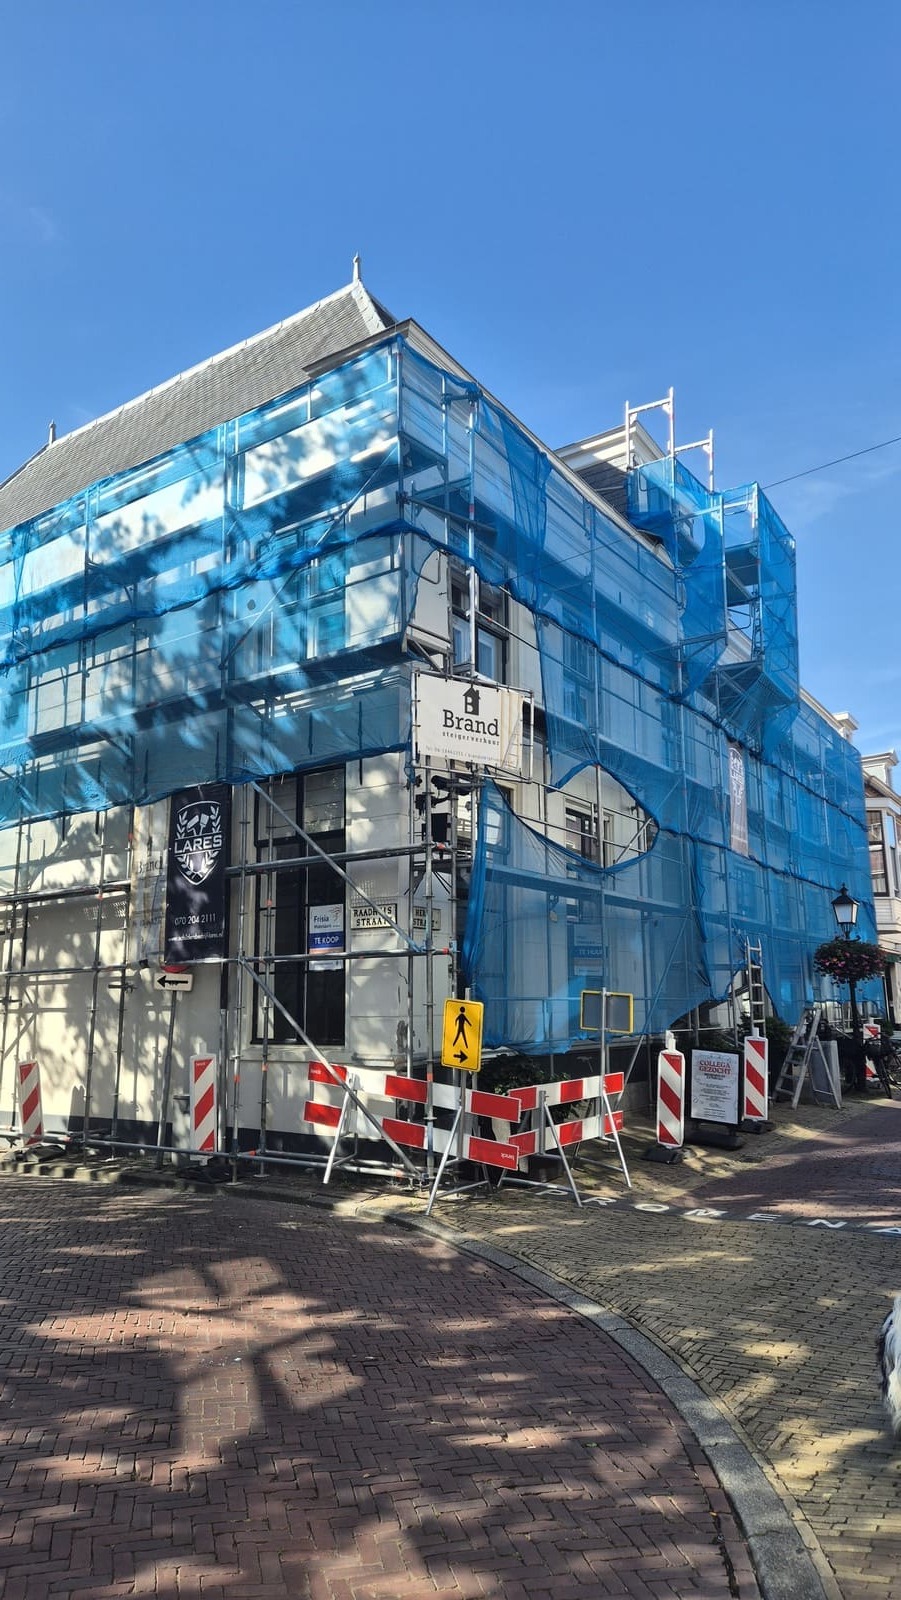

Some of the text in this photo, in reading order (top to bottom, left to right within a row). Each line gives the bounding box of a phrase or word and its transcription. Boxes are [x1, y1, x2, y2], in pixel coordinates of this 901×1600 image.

[442, 709, 500, 737] Brand
[442, 731, 500, 746] steigerverhuur
[174, 834, 222, 854] LARES
[174, 916, 187, 926] 070
[187, 915, 200, 925] 204
[200, 913, 216, 924] 2111
[314, 935, 340, 945] TE KOOP
[699, 1060, 731, 1069] COLLEGA
[699, 1066, 732, 1075] GEZOCHT
